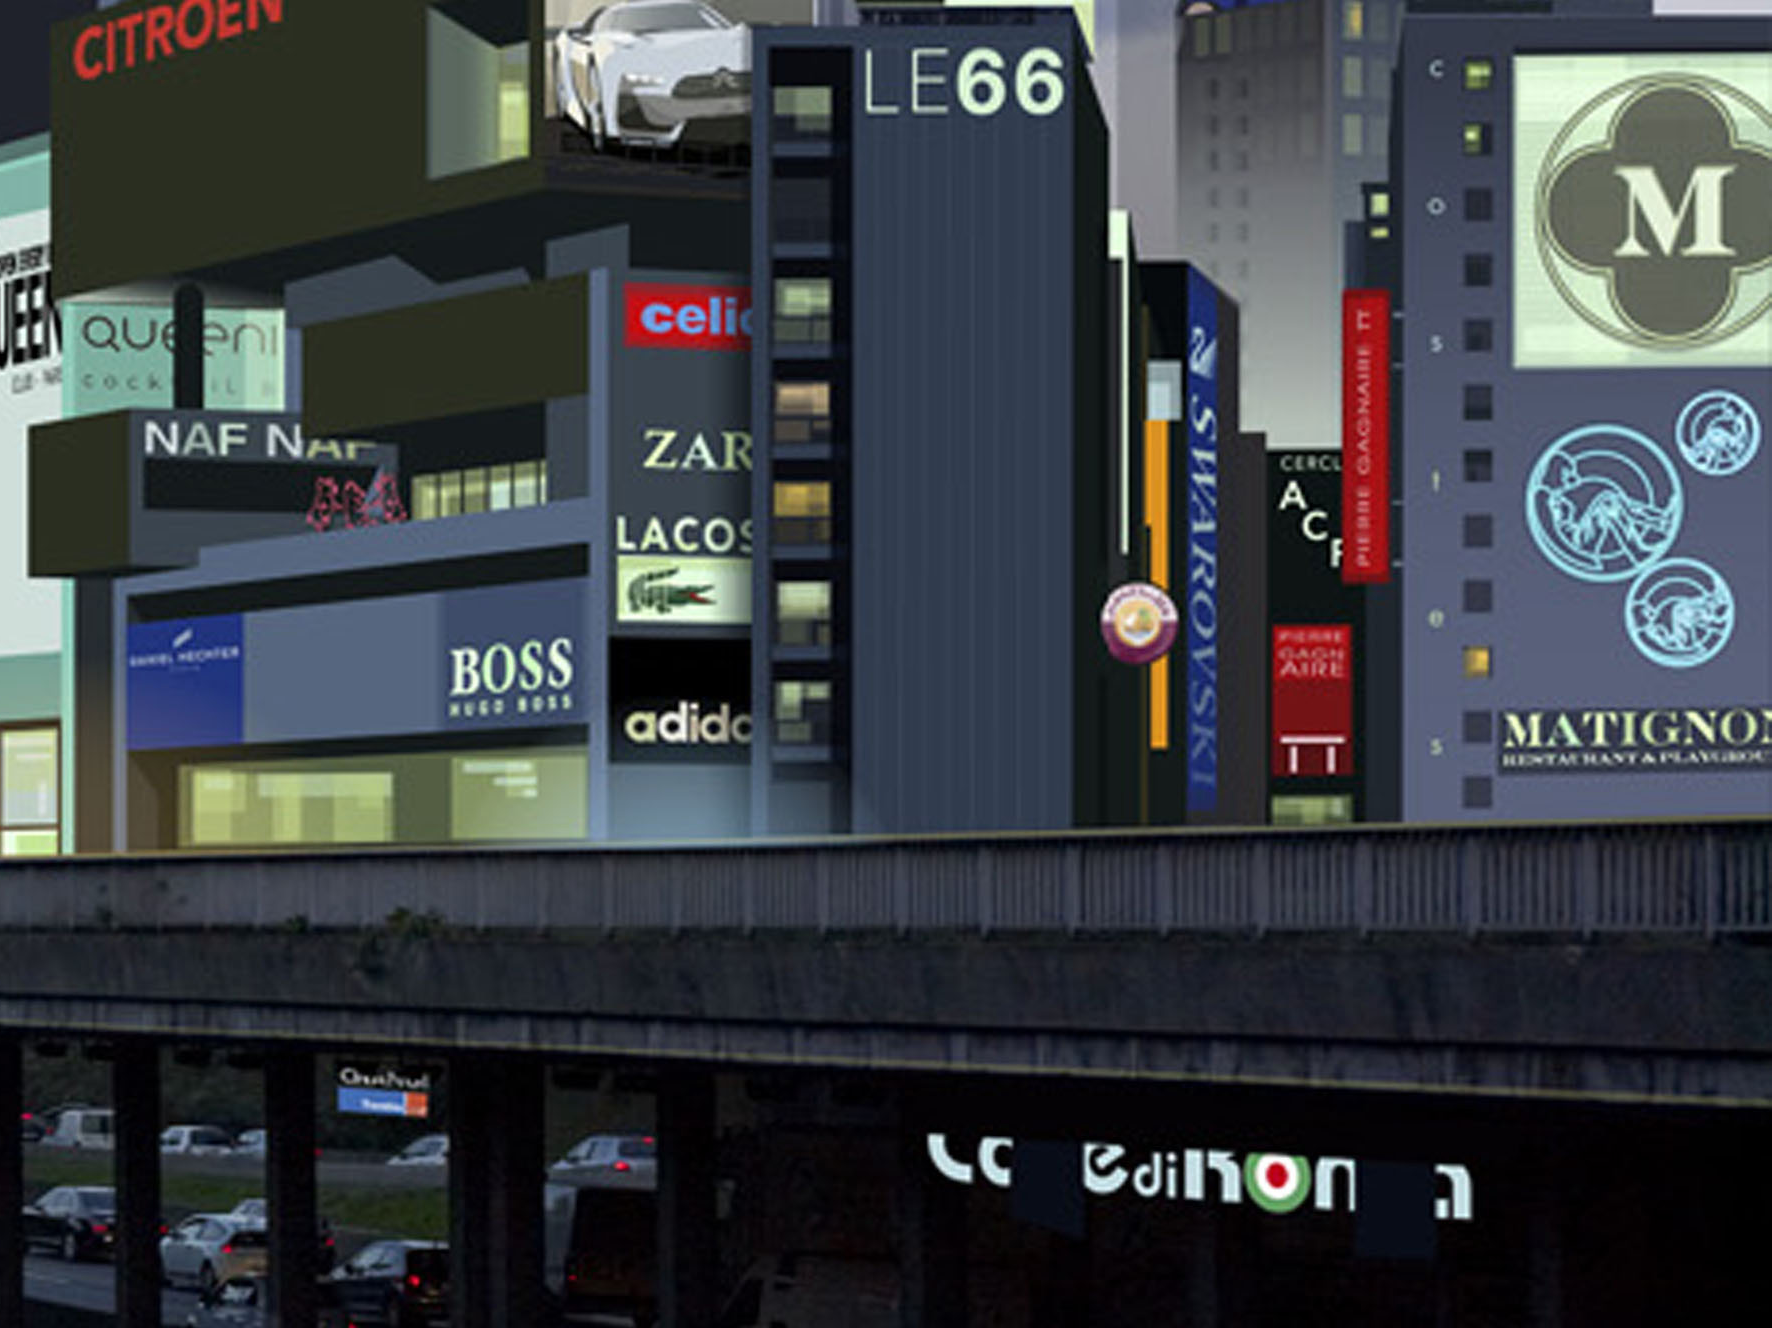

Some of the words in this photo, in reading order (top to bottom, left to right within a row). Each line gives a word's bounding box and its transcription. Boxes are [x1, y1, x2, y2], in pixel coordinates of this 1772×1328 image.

[1613, 164, 1738, 257] M
[144, 421, 248, 457] NAF
[1189, 393, 1218, 786] SWAROVSKI
[450, 637, 574, 696] BOSS
